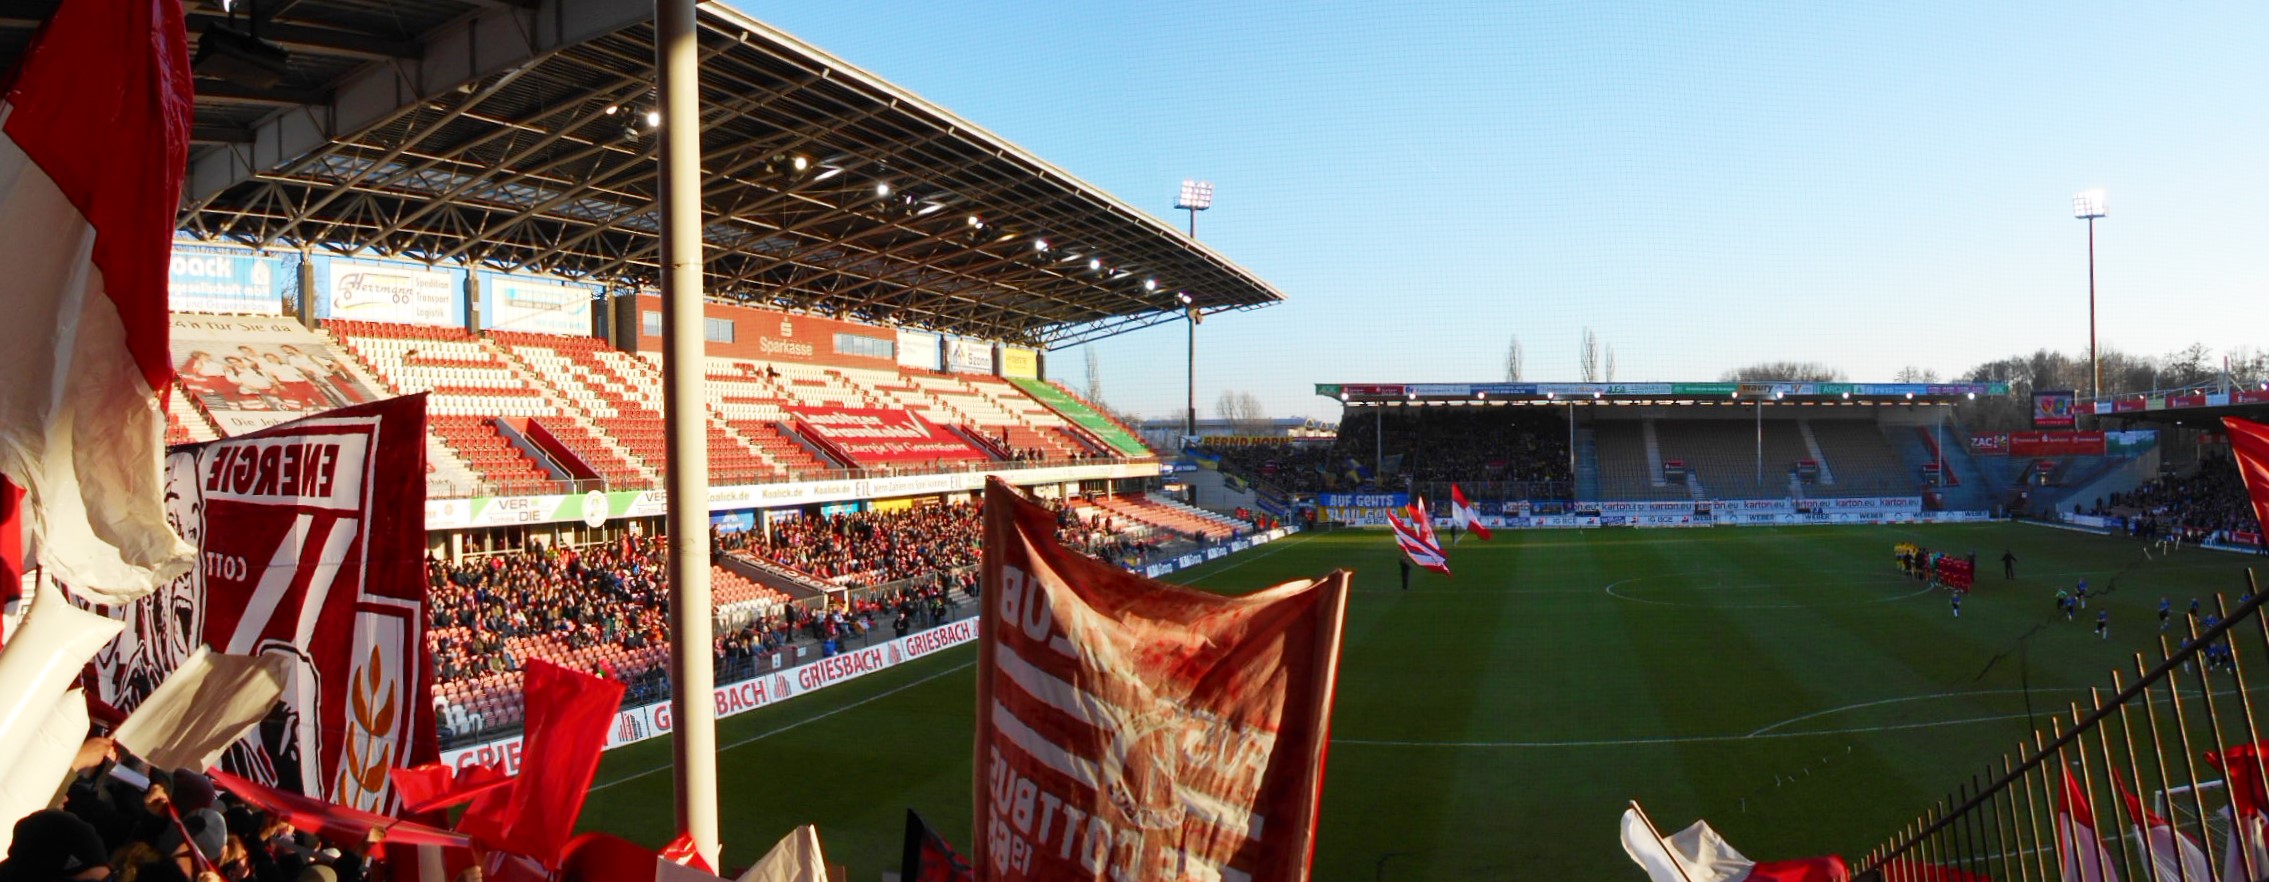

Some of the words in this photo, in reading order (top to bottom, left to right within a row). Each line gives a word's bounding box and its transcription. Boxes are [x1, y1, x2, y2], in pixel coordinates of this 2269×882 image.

[415, 277, 449, 289] Spedition
[416, 292, 449, 304] Transport
[416, 307, 444, 319] Logistik
[760, 336, 814, 356] Sparkasse
[498, 499, 528, 510] VER
[1330, 494, 1352, 507] AUF
[518, 511, 541, 522] DIE
[906, 621, 971, 657] GRIESBACH
[798, 648, 883, 690] GRIESBACH
